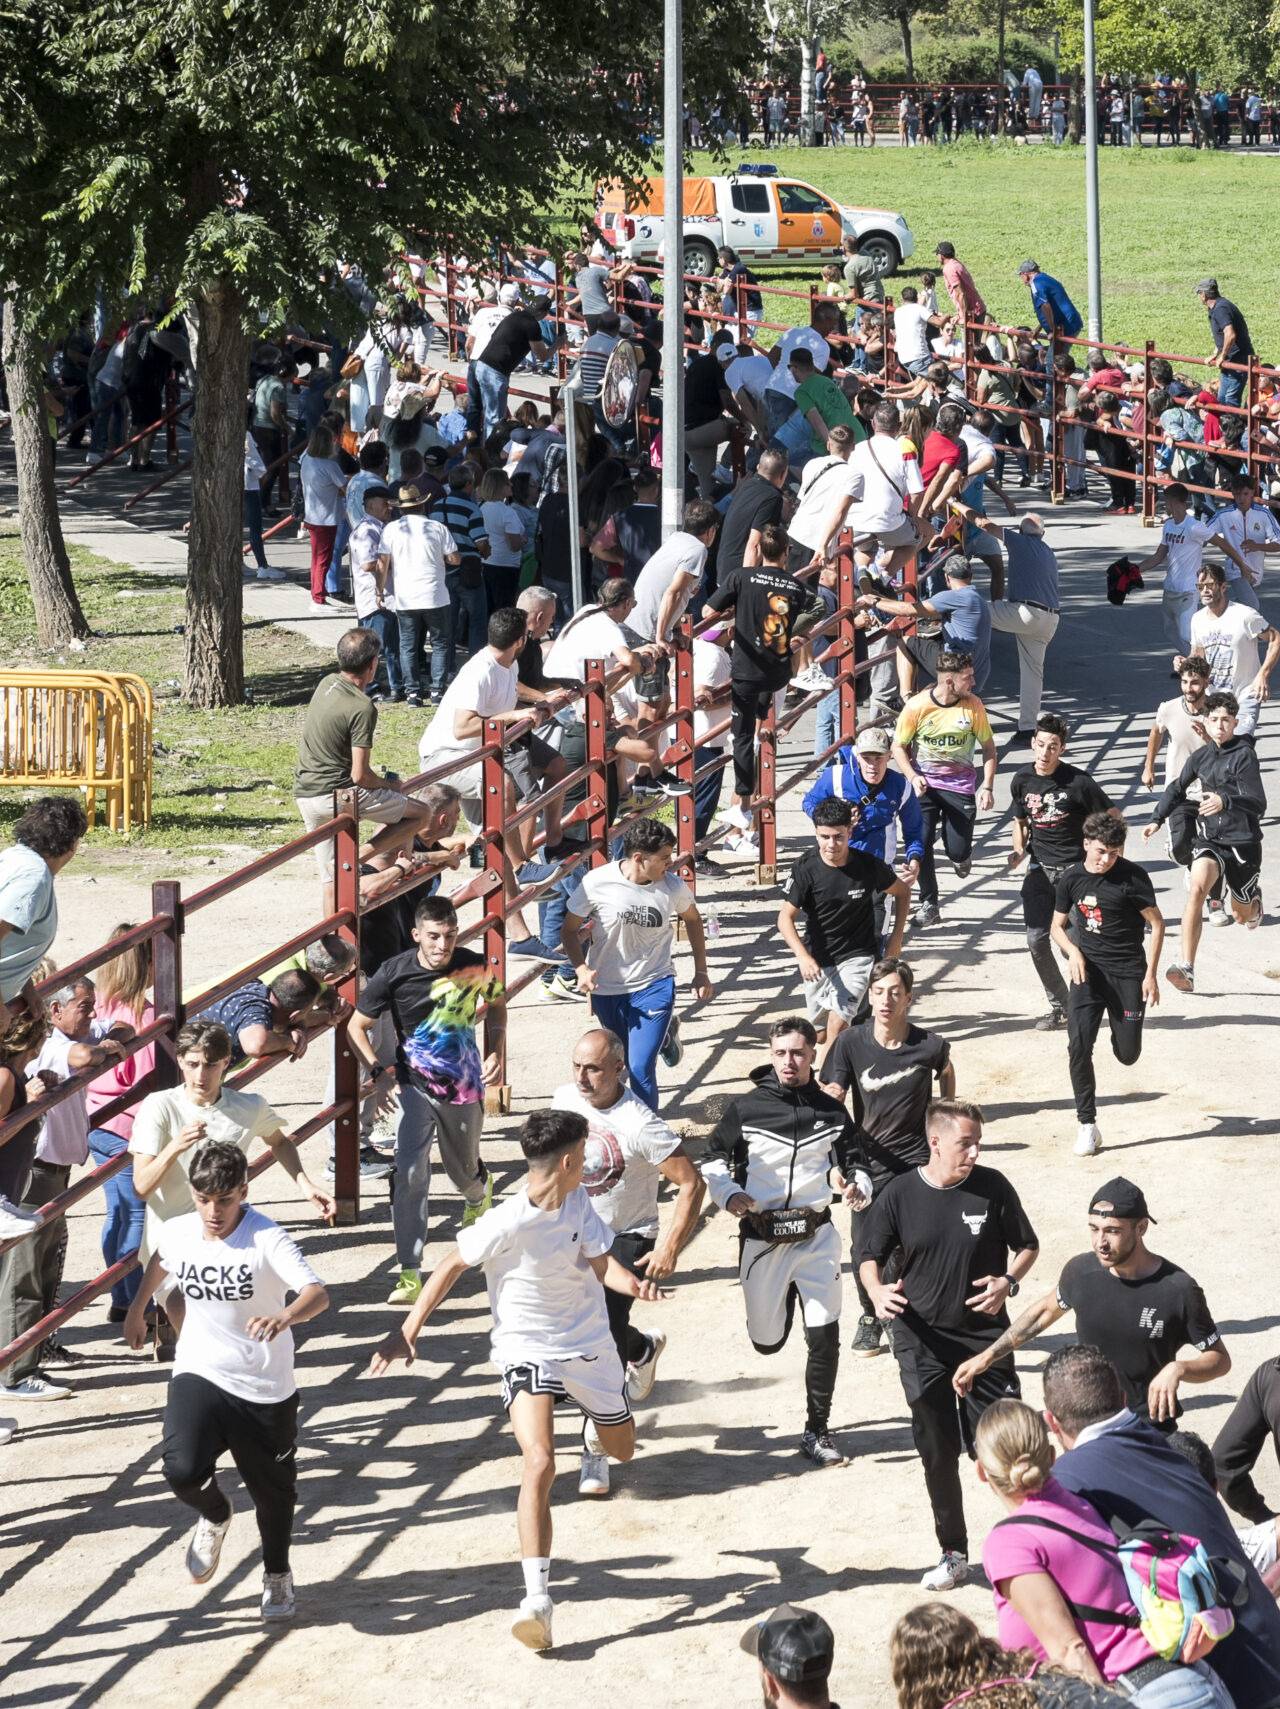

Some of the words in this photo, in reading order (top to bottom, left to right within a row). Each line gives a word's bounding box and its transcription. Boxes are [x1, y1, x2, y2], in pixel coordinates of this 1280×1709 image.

[631, 904, 647, 913] THE
[617, 911, 647, 920] NORTH
[626, 918, 647, 927] FACE
[774, 1224, 806, 1236] COUTURE
